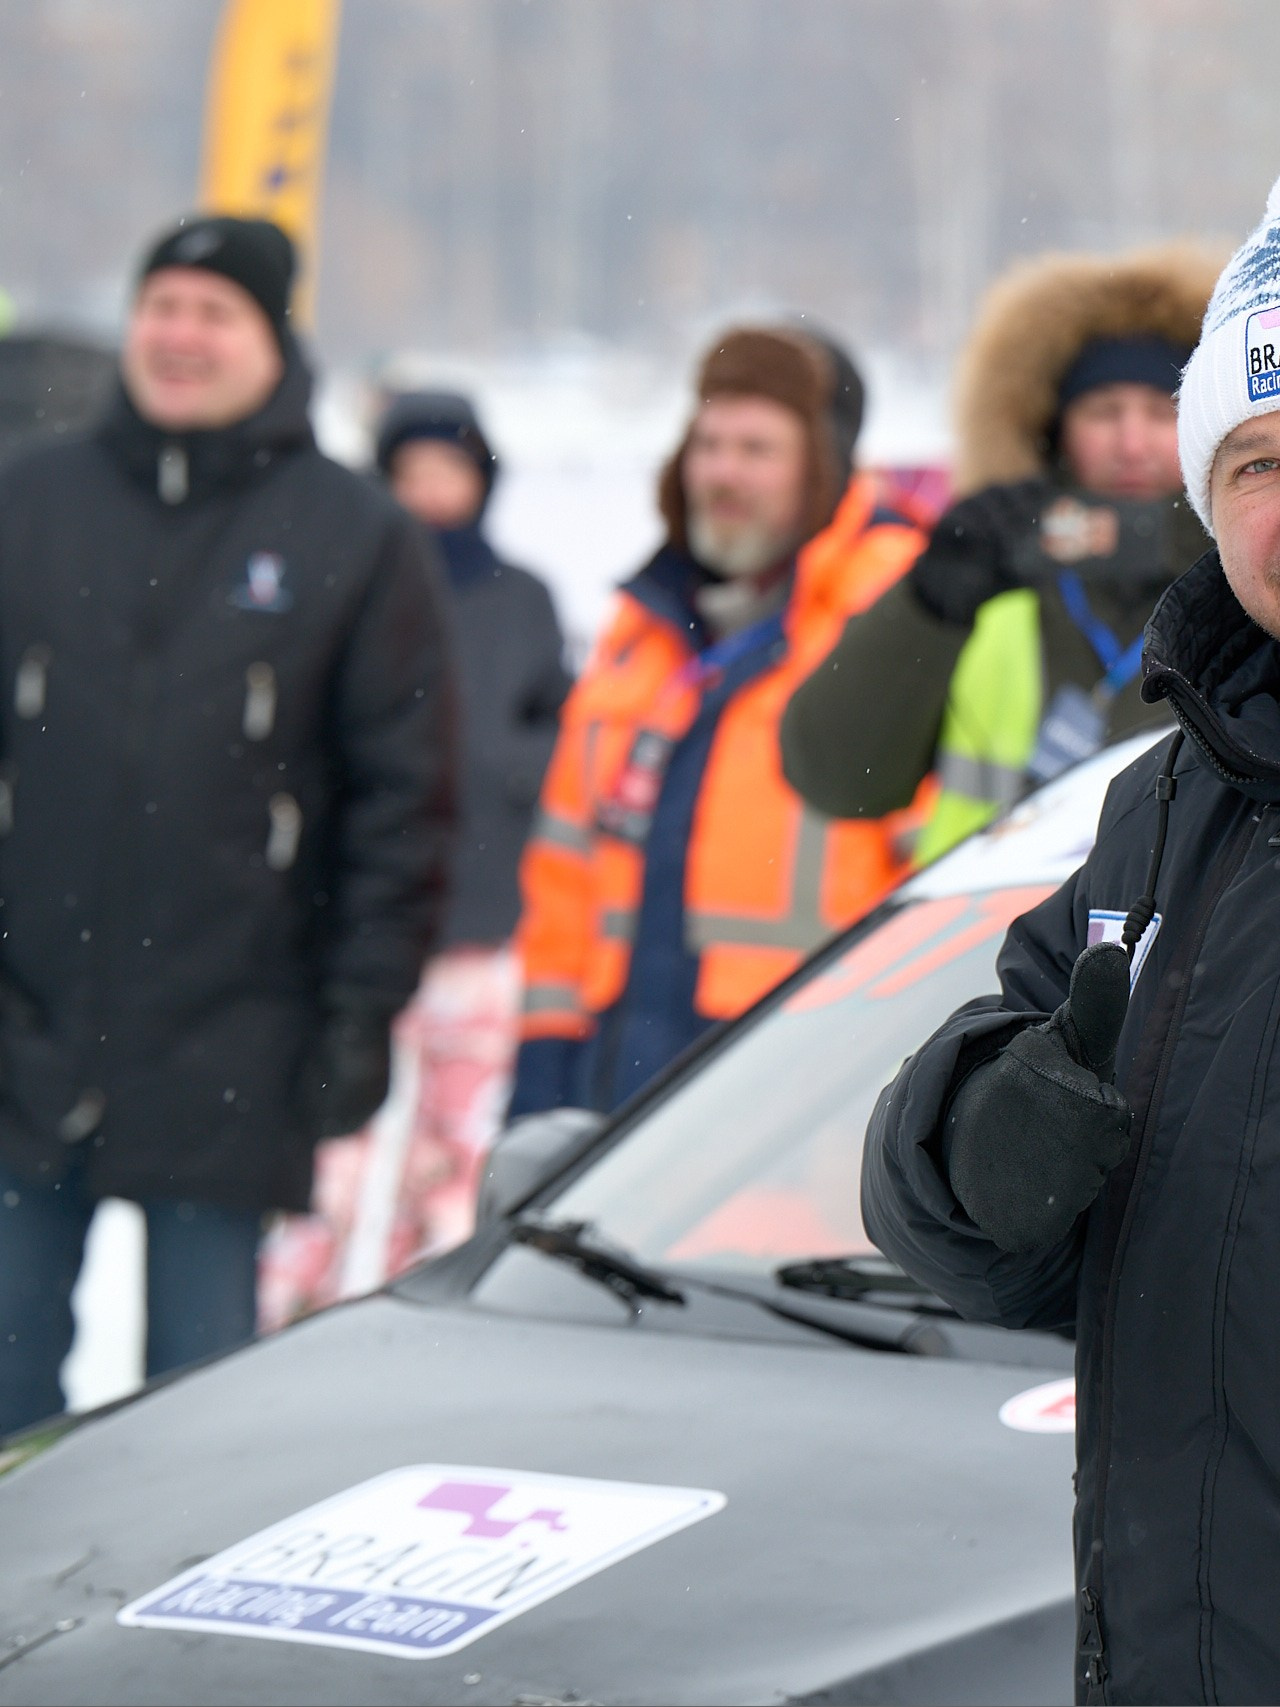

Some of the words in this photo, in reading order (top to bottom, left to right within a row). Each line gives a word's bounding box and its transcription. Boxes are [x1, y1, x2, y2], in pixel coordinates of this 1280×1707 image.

[232, 1530, 570, 1600] BRAGIN
[161, 1579, 338, 1629] Racing
[327, 1592, 468, 1642] Team
